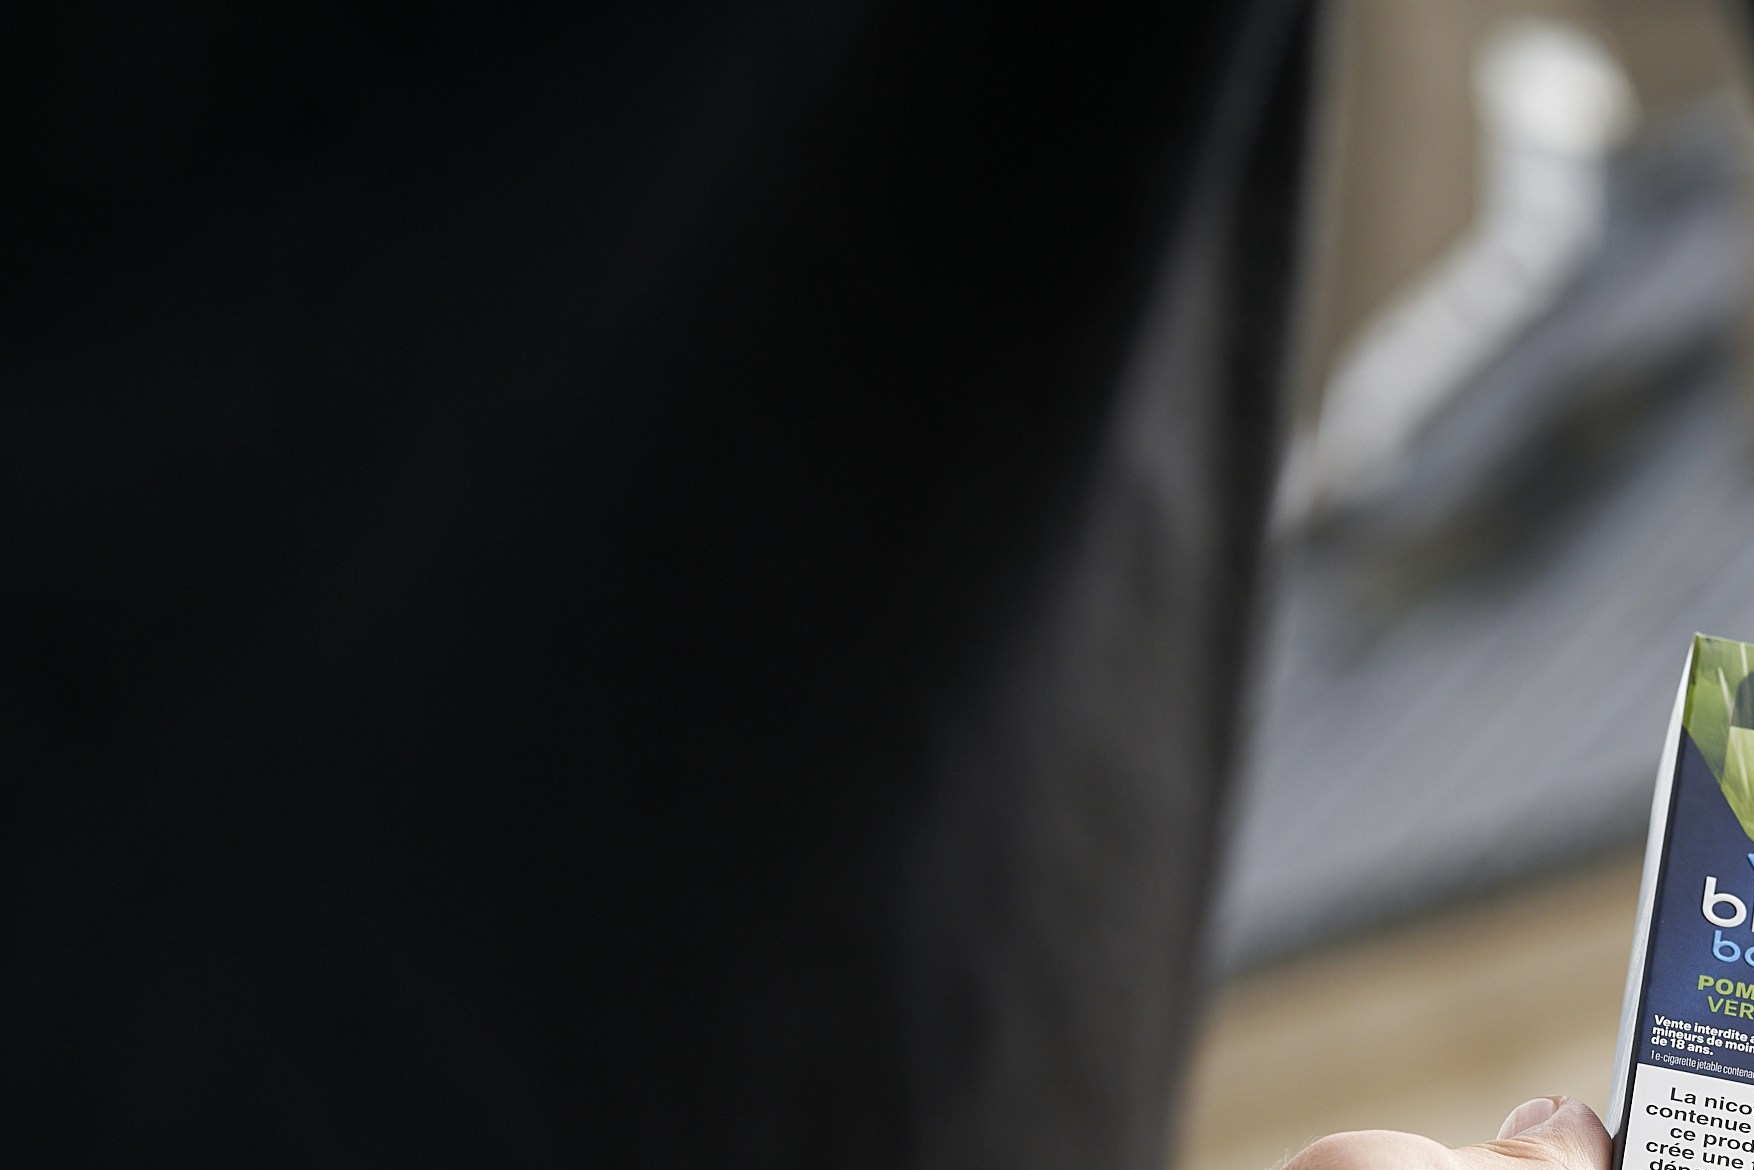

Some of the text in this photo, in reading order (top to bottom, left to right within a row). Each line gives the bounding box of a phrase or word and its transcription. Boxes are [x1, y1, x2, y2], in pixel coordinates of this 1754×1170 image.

[1652, 1026, 1704, 1044] mineurs
[1706, 1036, 1723, 1047] de
[1654, 1014, 1692, 1031] Vente
[1694, 1022, 1748, 1042] interdite
[1651, 1036, 1714, 1056] de 18 ans.
[1655, 1053, 1696, 1067] e-cigarette
[1696, 1059, 1722, 1072] jetable
[1670, 1087, 1696, 1105] La
[1646, 1104, 1752, 1134] contenue
[1670, 1127, 1696, 1142] ce
[1646, 1141, 1694, 1160] crée
[1702, 1152, 1744, 1169] une
